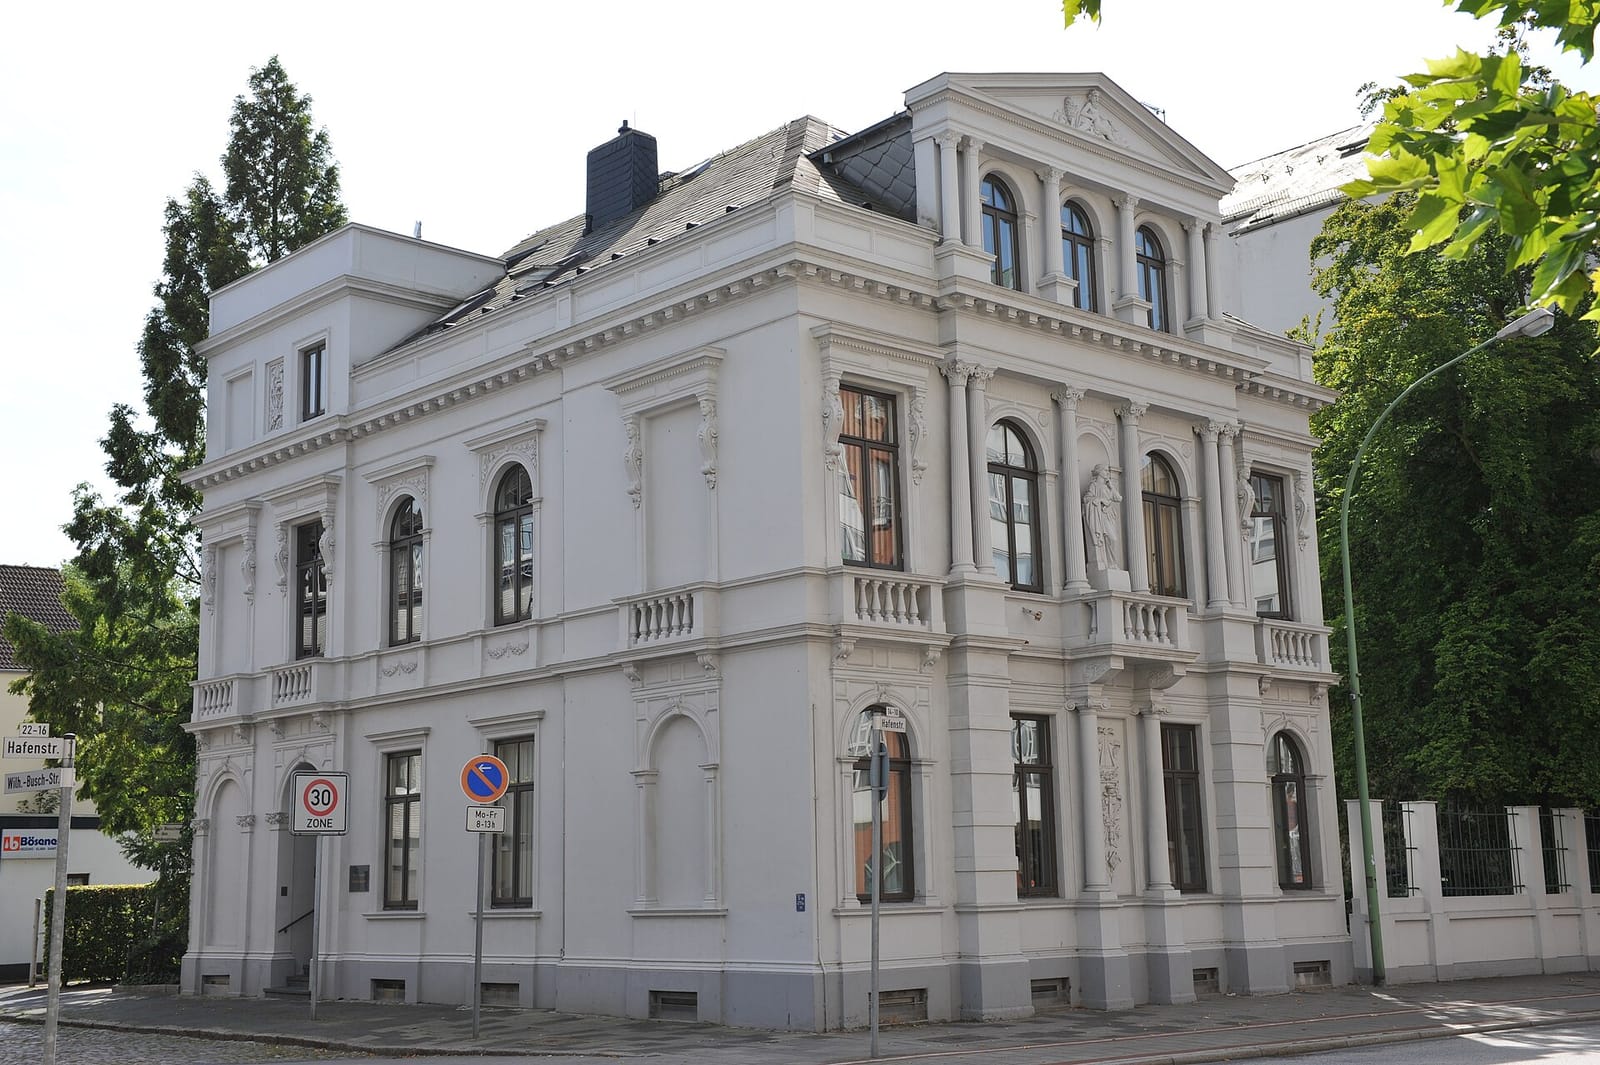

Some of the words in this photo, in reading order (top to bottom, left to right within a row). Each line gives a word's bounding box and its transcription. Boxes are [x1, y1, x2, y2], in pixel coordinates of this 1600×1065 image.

[22, 725, 47, 735] 22-16
[881, 719, 905, 730] Hafenstr.
[7, 740, 60, 754] Hafenstr.
[7, 772, 60, 790] Wilh.-Busch-Str.
[310, 788, 331, 806] 30
[475, 810, 498, 818] Mo-Fr
[306, 818, 333, 828] ZONE
